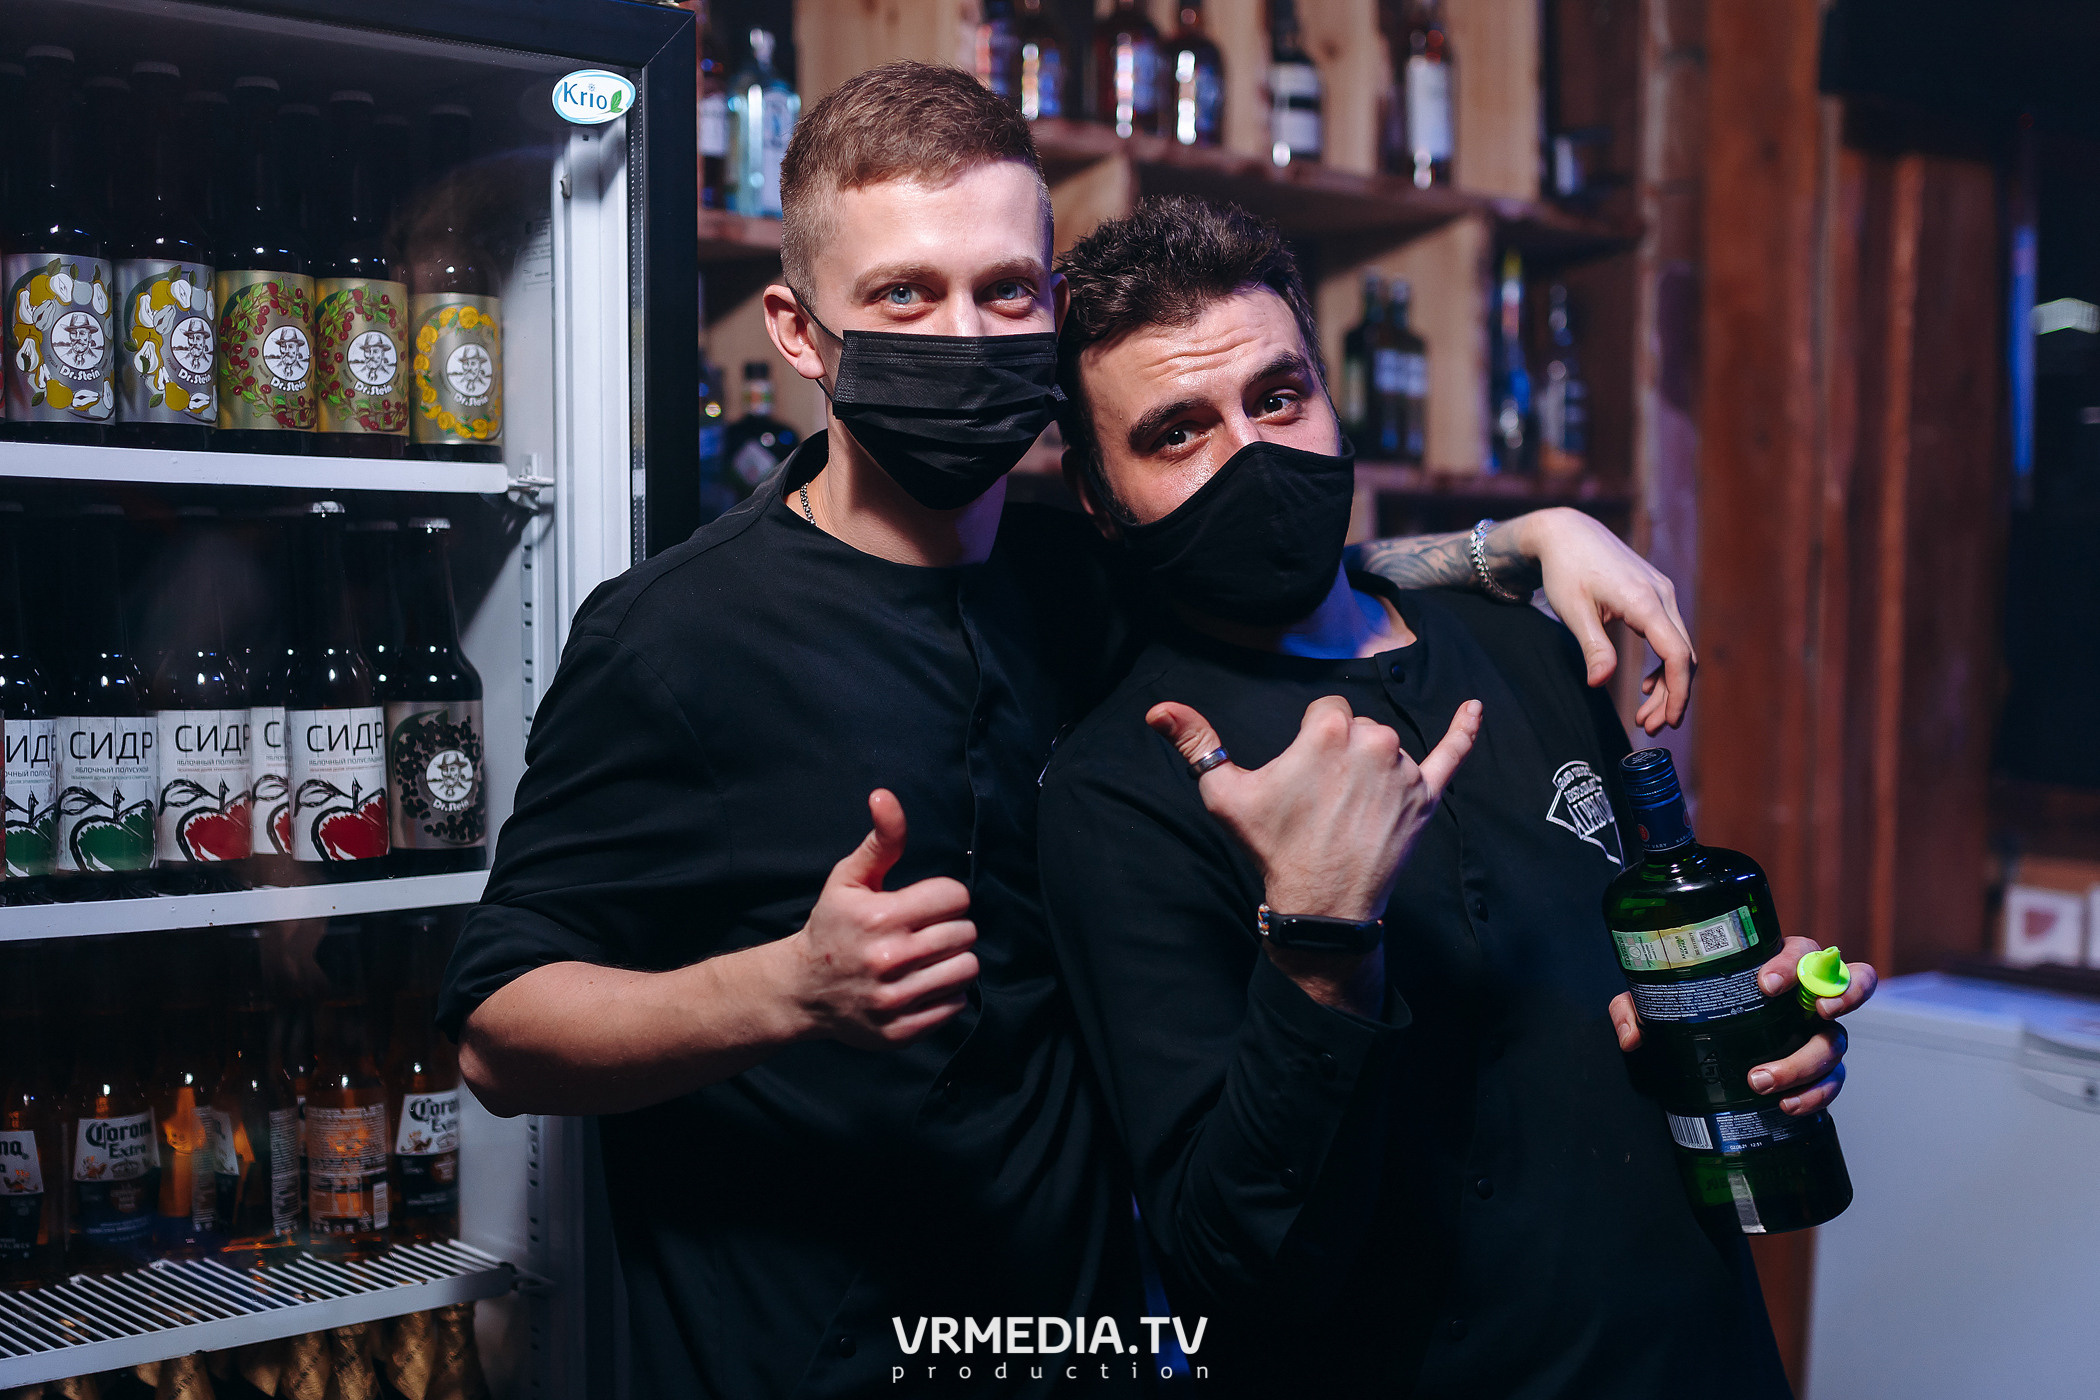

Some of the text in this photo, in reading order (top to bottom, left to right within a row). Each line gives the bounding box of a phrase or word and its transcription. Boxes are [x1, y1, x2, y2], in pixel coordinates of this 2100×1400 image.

[563, 82, 608, 110] Krio
[59, 364, 101, 381] Dr.Stein
[177, 368, 212, 384] Dr.Stein
[270, 376, 307, 392] Dr.Stein
[354, 380, 393, 396] Dr.Stein
[69, 731, 153, 765] СИДР
[175, 724, 249, 757] СИДР
[306, 722, 383, 756] СИДР
[6, 735, 56, 768] ИДР
[432, 798, 470, 812] Dr.Stein
